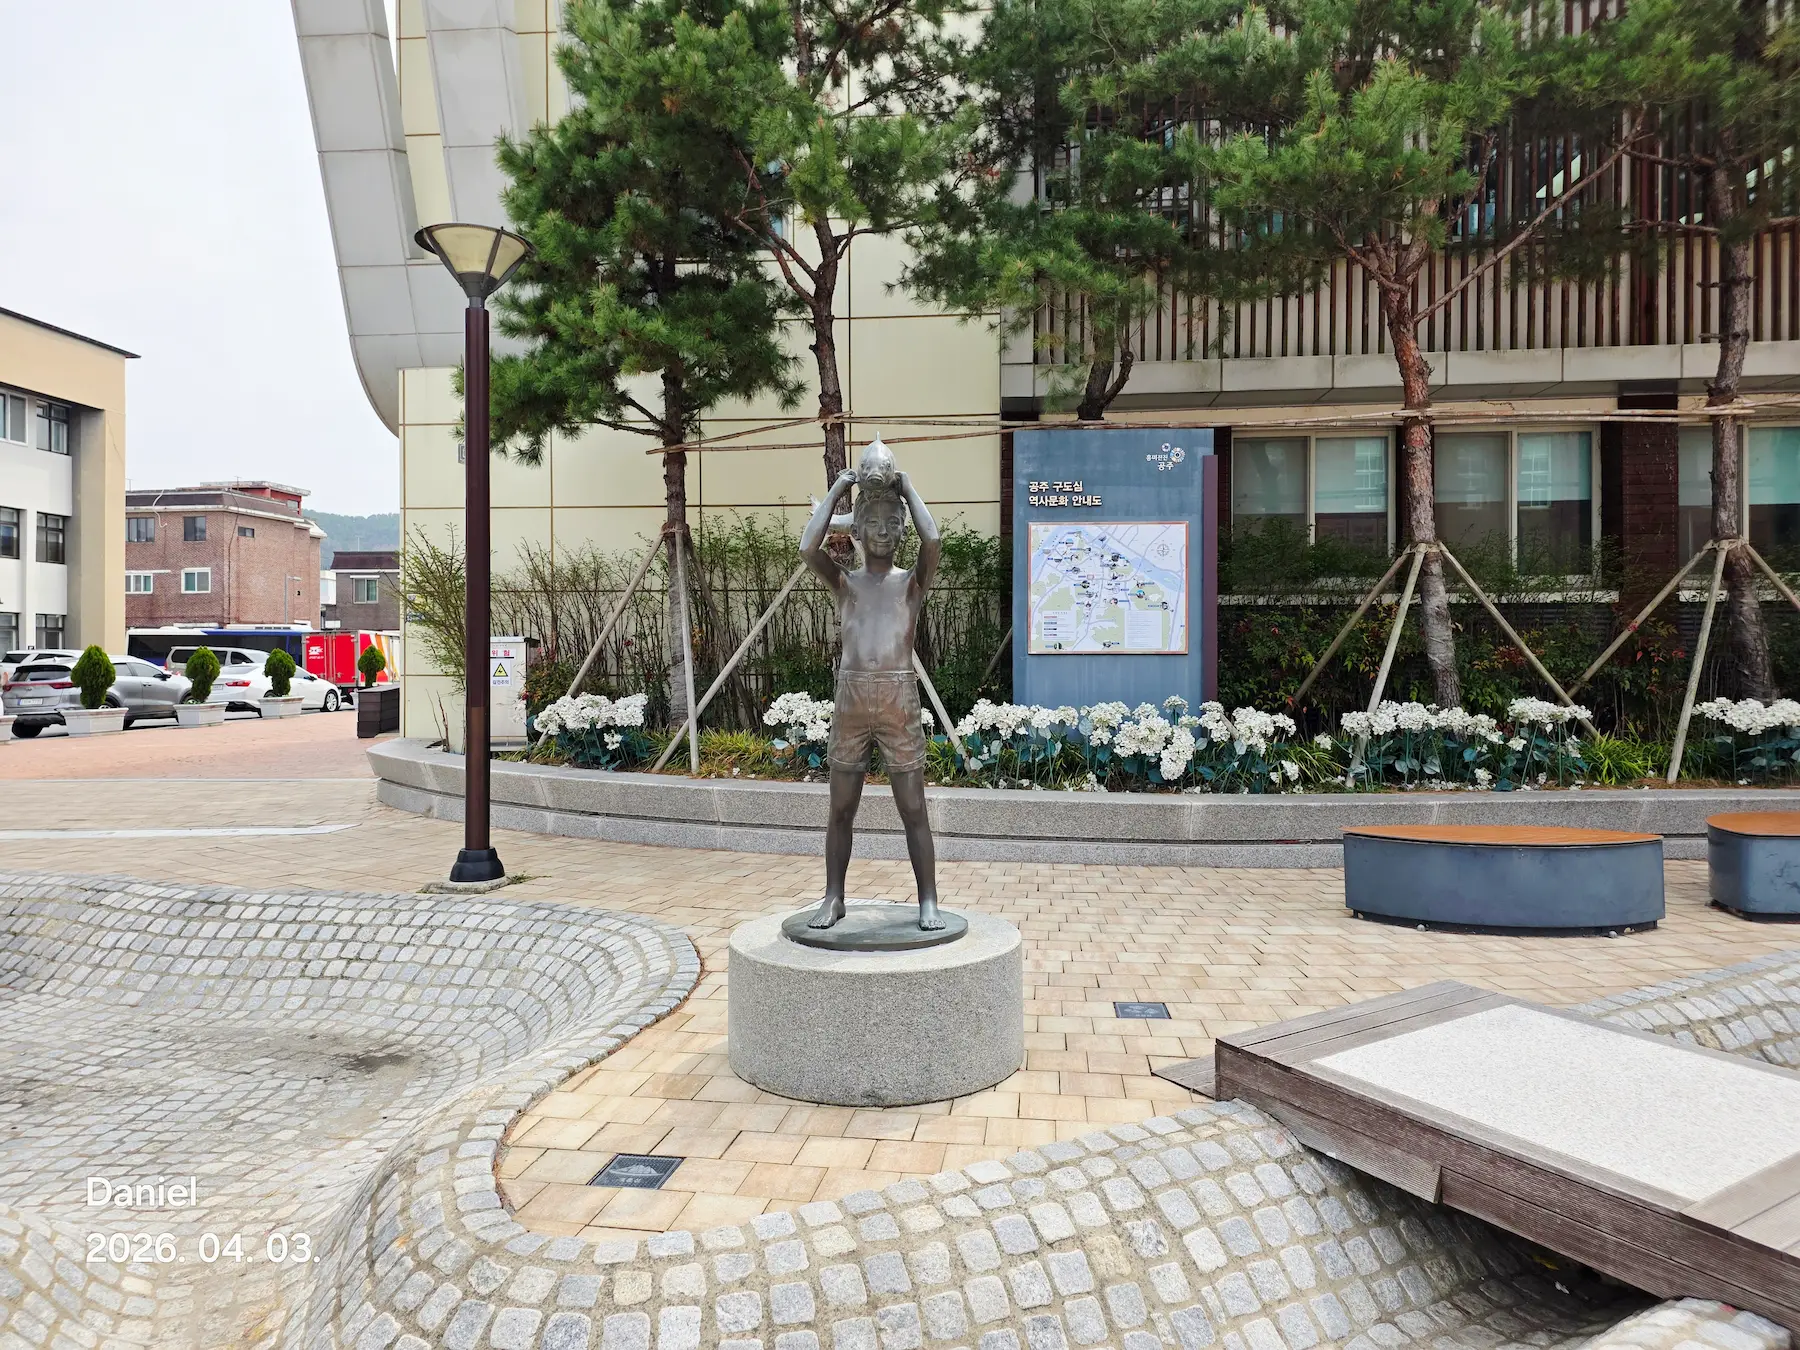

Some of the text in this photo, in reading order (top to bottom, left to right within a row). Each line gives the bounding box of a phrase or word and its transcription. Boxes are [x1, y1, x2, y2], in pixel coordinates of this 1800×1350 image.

[1158, 462, 1174, 471] 공주
[1028, 480, 1083, 493] 공주 구도심
[1028, 495, 1103, 507] 역사문화 안내도
